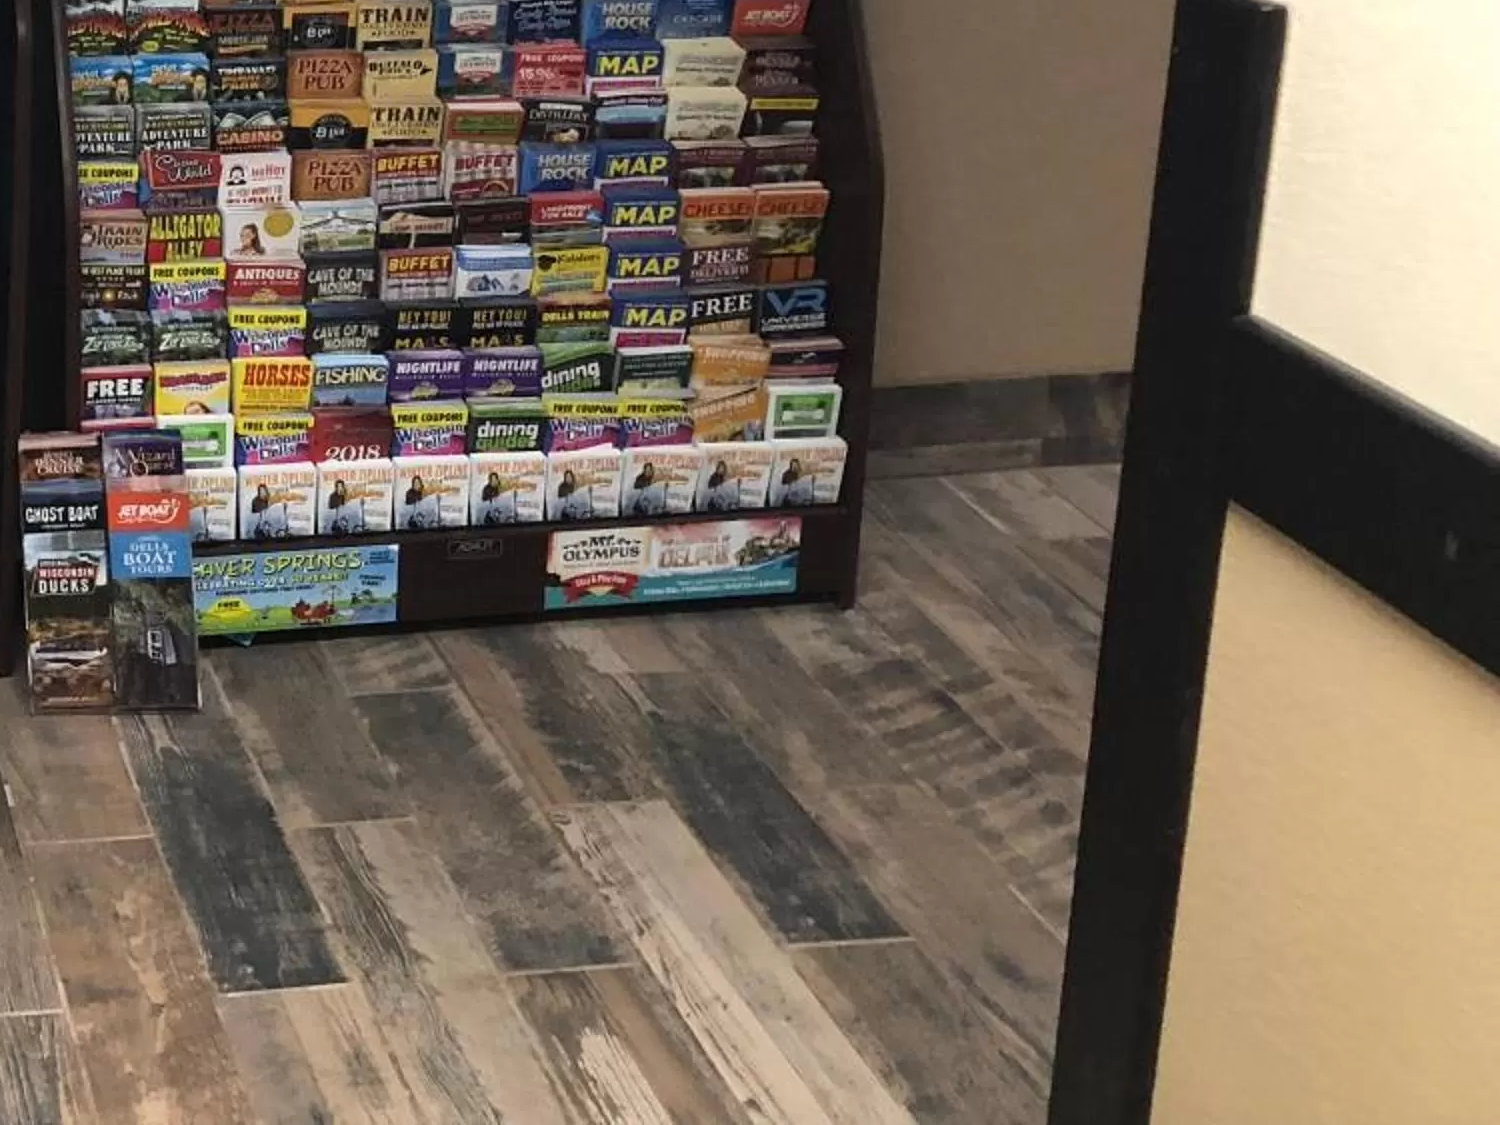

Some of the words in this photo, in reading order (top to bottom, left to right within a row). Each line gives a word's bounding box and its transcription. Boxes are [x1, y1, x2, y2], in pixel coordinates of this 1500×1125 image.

[359, 8, 429, 23] TRAIN
[602, 2, 653, 15] HOUSE
[605, 16, 651, 30] ROCK
[298, 59, 353, 73] PIZZA
[600, 55, 659, 75] MAP
[305, 75, 345, 90] PUB
[373, 106, 440, 121] TRAIN
[142, 128, 207, 140] ADVENTURE
[217, 131, 284, 145] CASINO
[156, 140, 191, 150] PARK
[308, 161, 362, 175] PIZZA
[377, 155, 438, 171] BUFFET
[455, 154, 515, 171] BUFFET
[538, 155, 592, 167] HOUSE
[610, 157, 668, 176] MAP
[92, 168, 133, 178] COUPONS
[541, 167, 589, 179] ROCK
[314, 178, 354, 192] PUB
[616, 206, 677, 225] MAP
[150, 214, 220, 239] ALLIGATOR
[166, 242, 203, 261] ALLEY
[692, 247, 749, 266] FREE
[388, 256, 449, 271] BUFFET
[620, 258, 680, 276] MAP
[177, 267, 219, 277] COUPONS
[235, 268, 300, 280] ANTIQUES
[692, 293, 753, 318] FREE
[766, 289, 828, 316] VR
[234, 315, 255, 323] FREE
[258, 315, 300, 323] COUPONS
[626, 309, 687, 326] MAP
[312, 326, 340, 339] CAVE
[323, 338, 367, 350] MOUNDS
[396, 361, 460, 374] NIGHTLIFE
[473, 358, 538, 372] NIGHTLIFE
[244, 363, 311, 386] HORSES
[315, 366, 387, 385] FISHING
[541, 361, 600, 388] dining
[86, 378, 144, 398] FREE
[421, 413, 463, 423] COUPONS
[243, 421, 263, 430] FREE
[477, 421, 538, 439] dining
[326, 445, 381, 462] 2018
[26, 506, 64, 523] GHOST
[68, 505, 99, 521] BOAT
[141, 503, 170, 516] BOAT
[123, 551, 177, 565] BOAT
[563, 547, 640, 561] OLYMPUS
[263, 550, 365, 574] SPRINGS
[39, 568, 94, 578] WISCONSIN
[130, 565, 172, 574] TOURS
[38, 579, 89, 594] DUCKS
